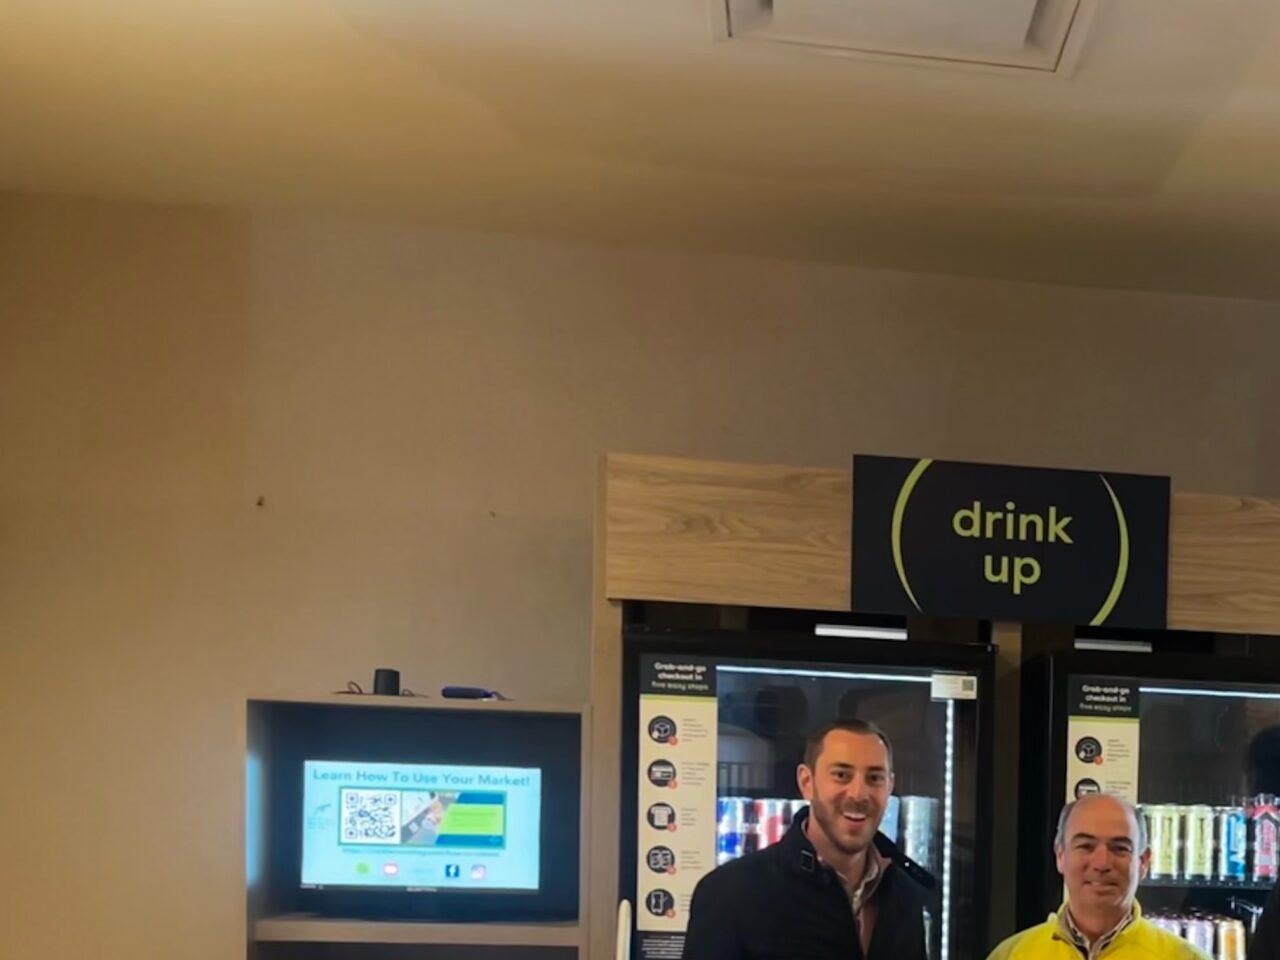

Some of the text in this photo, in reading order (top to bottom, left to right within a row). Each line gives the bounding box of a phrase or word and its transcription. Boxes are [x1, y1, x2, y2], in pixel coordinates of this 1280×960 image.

[952, 500, 1074, 545] drink
[983, 554, 1041, 595] up
[313, 769, 530, 787] Learn How To Use Your Market!
